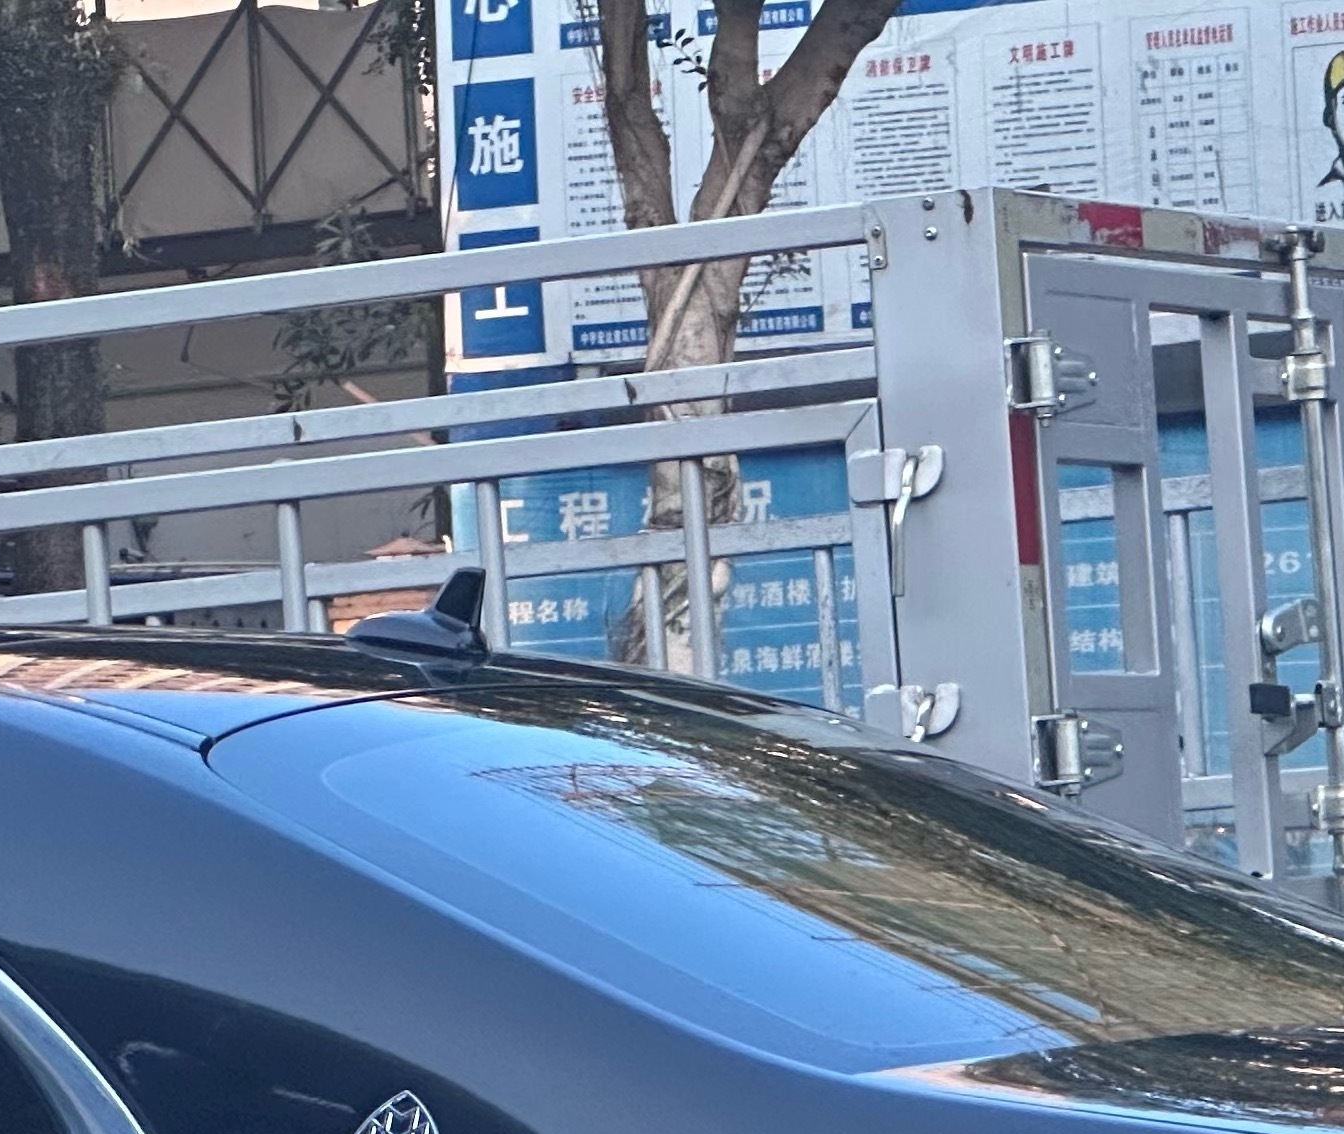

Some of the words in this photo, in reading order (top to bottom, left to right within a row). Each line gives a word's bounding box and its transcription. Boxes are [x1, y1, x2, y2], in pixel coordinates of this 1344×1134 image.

[1008, 40, 1074, 64] 文明施工牌
[502, 480, 773, 542] 工程况
